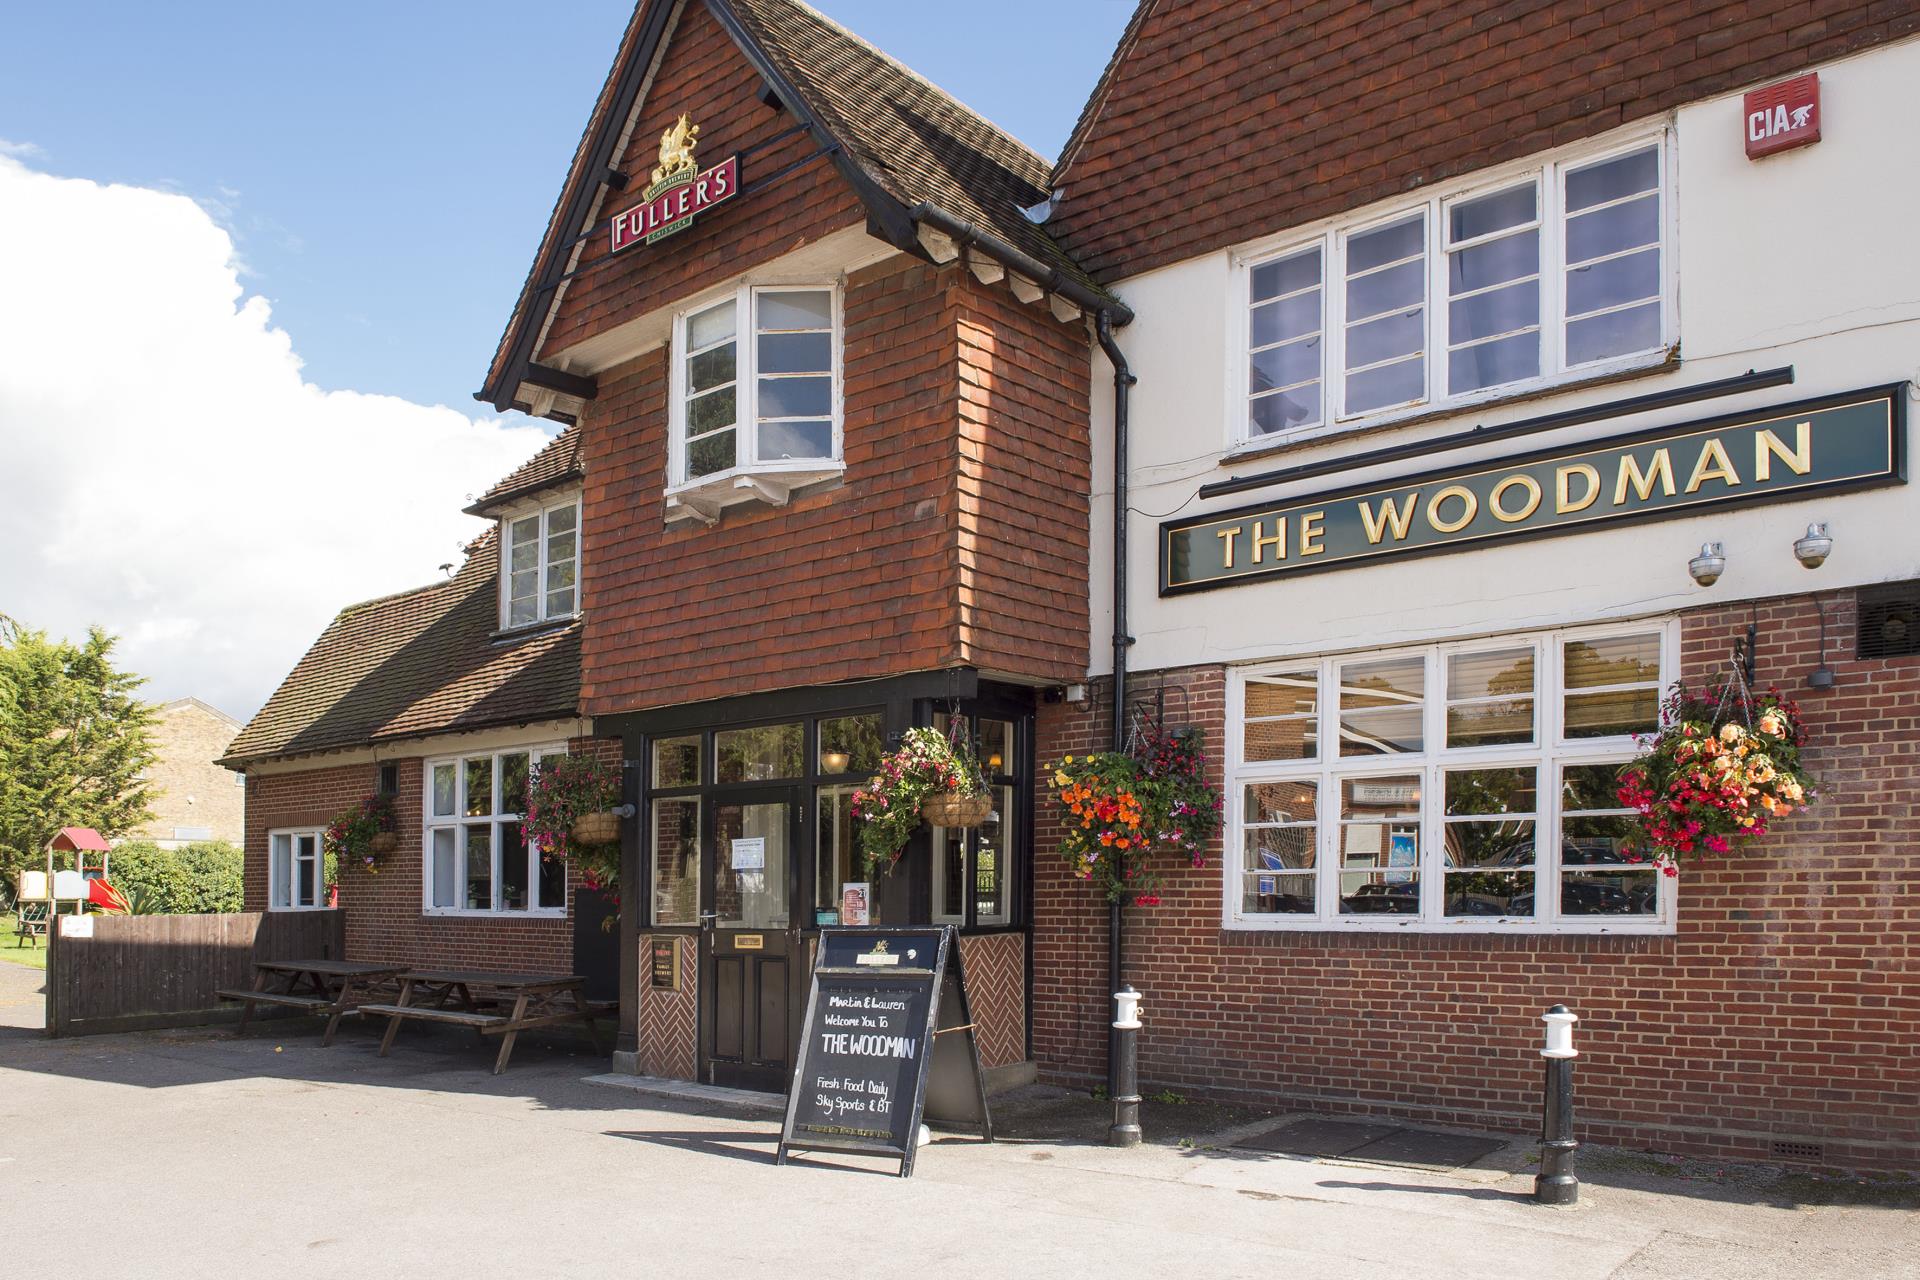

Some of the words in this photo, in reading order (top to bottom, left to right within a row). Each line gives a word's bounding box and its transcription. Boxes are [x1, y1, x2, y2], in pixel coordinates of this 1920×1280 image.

[1749, 104, 1790, 141] CIA
[617, 169, 726, 244] FULLER'S
[1217, 511, 1325, 568] THE
[1357, 421, 1811, 545] WOODMAN
[829, 996, 862, 1008] Martin
[863, 996, 871, 1009] &
[871, 997, 905, 1010] Lauren
[824, 1014, 860, 1026] Welcome
[861, 1015, 876, 1028] You
[878, 1016, 888, 1028] To
[821, 1033, 849, 1054] THE
[850, 1034, 916, 1059] WOODMAN
[817, 1076, 840, 1089] Fresh
[843, 1078, 865, 1092] Food
[868, 1080, 888, 1101] Daily
[815, 1094, 834, 1115] Sky
[835, 1096, 865, 1116] Sports
[869, 1099, 876, 1112] &
[877, 1099, 892, 1113] BT
